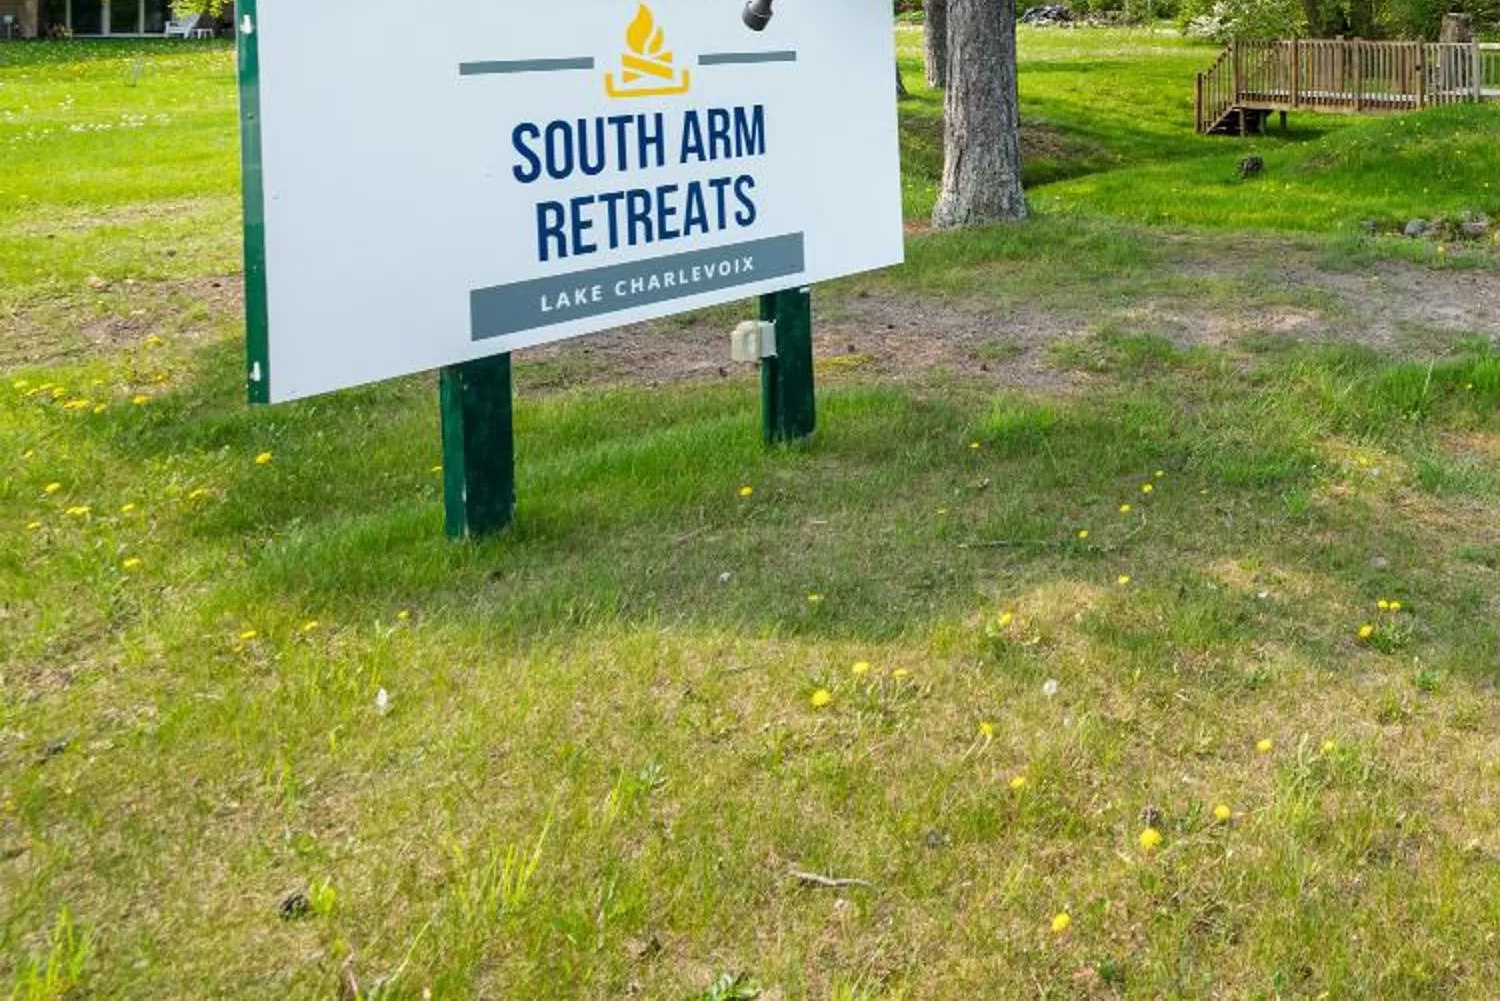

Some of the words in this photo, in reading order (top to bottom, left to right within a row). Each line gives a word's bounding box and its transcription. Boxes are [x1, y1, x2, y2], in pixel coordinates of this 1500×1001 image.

[512, 112, 665, 184] SOUTH
[679, 104, 766, 164] ARM
[536, 174, 757, 262] RETREATS
[540, 284, 604, 312] LAKE
[614, 256, 754, 297] CHARLEVOIX
